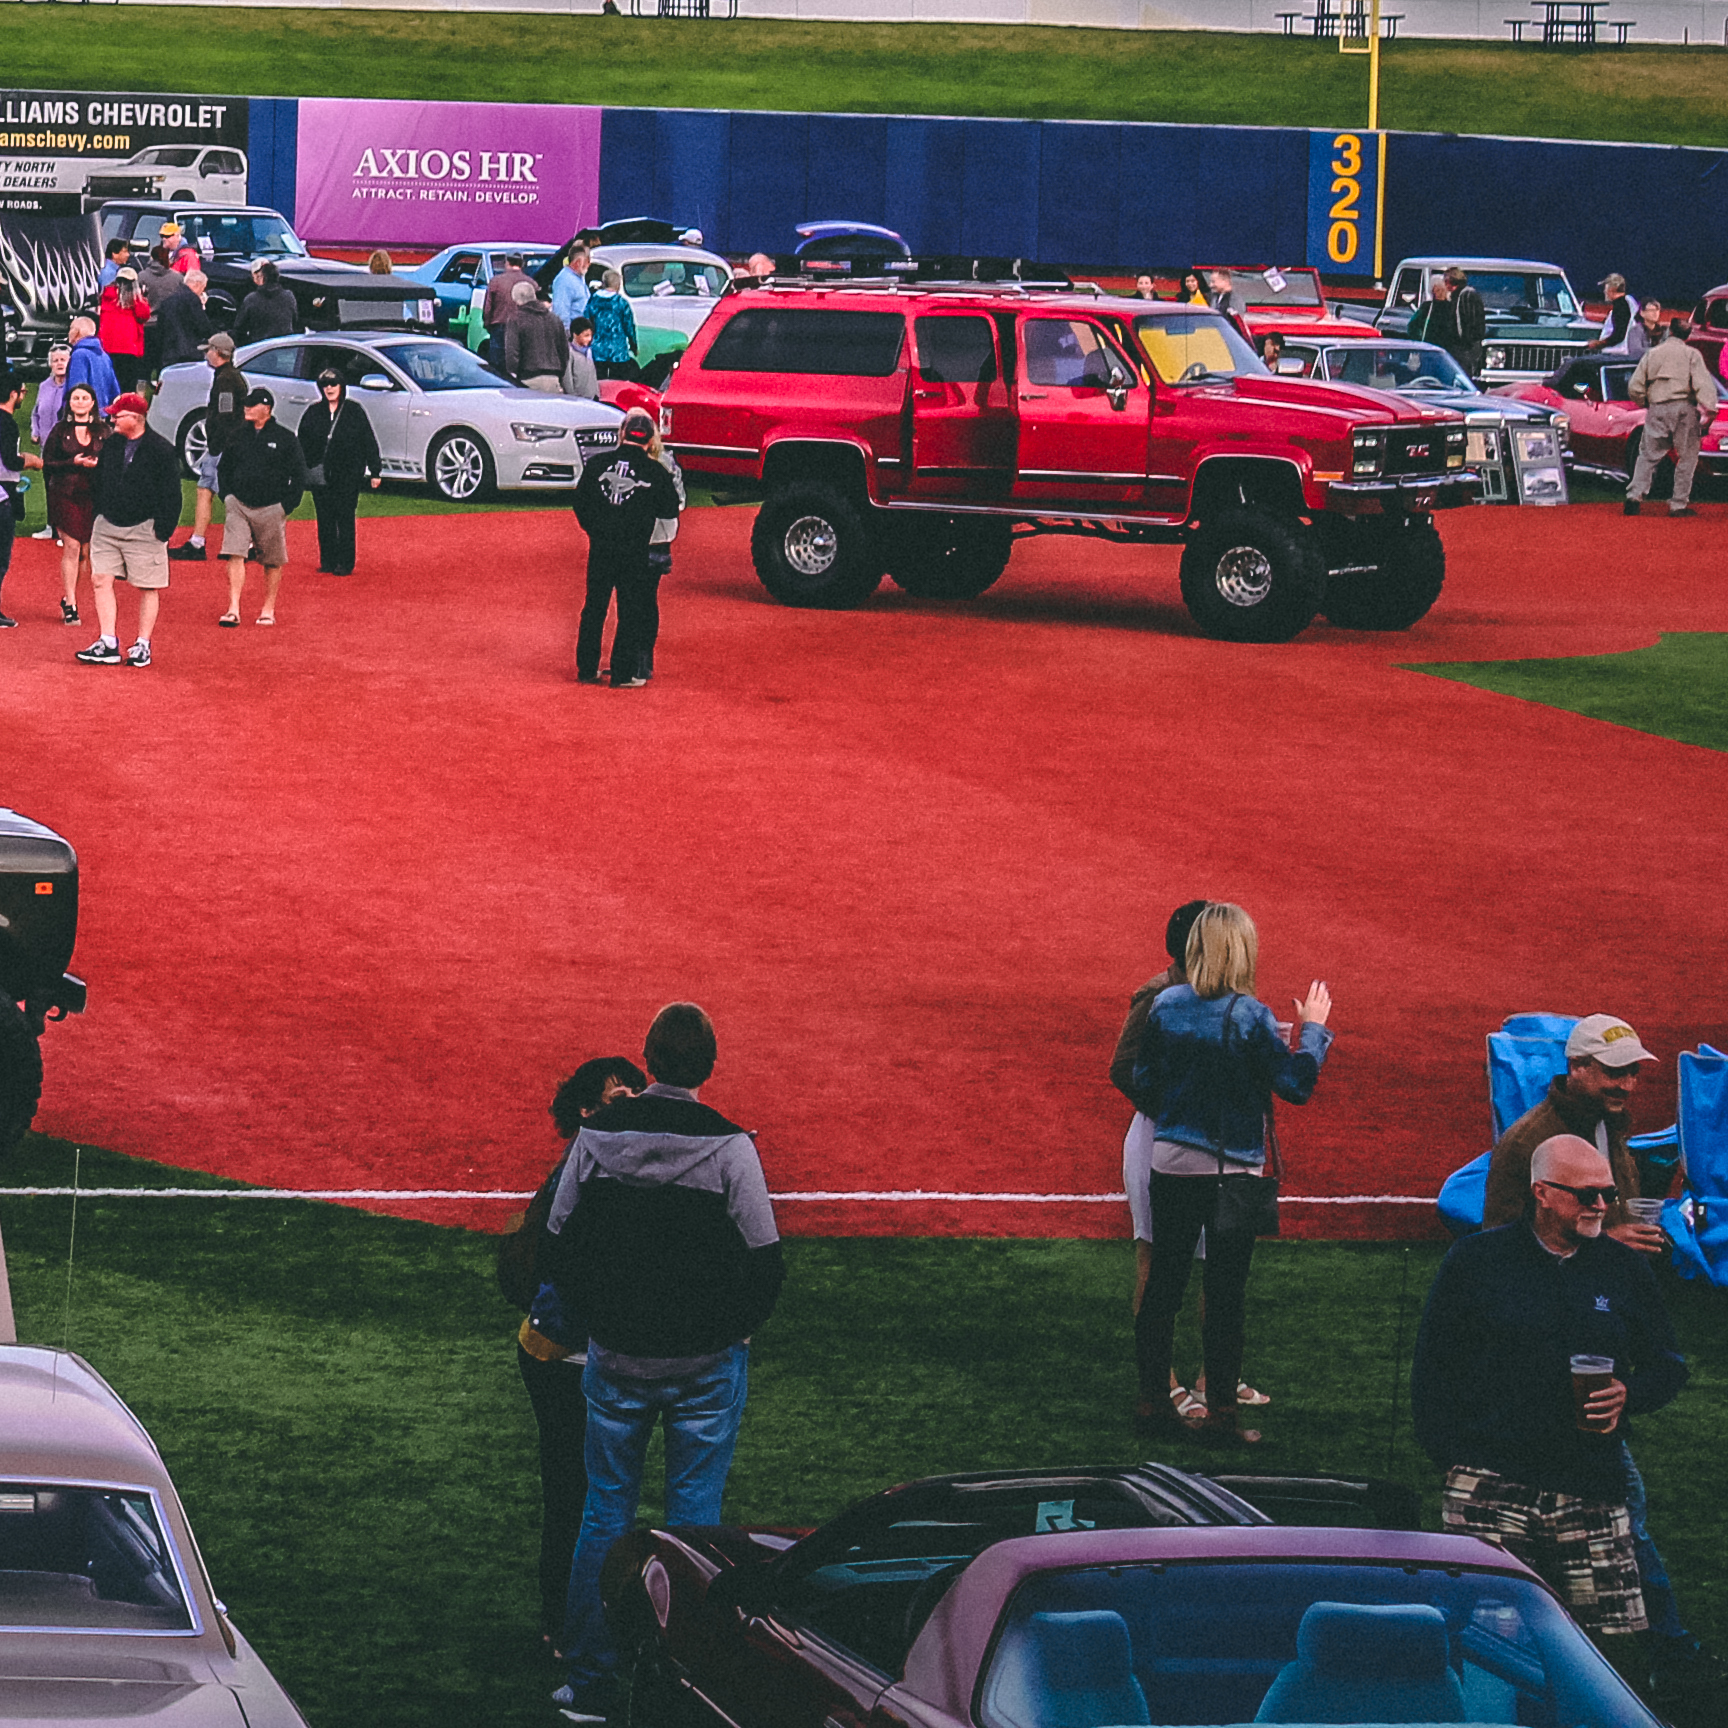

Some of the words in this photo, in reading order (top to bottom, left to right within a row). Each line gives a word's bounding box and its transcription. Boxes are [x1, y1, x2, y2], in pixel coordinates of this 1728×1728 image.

[87, 101, 227, 129] CHEVROLET
[13, 161, 56, 174] NORTH
[351, 147, 472, 181] AXIOS
[2, 176, 58, 189] DEALERS
[352, 187, 416, 201] ATTRACT.
[418, 189, 472, 203] RETAIN.
[1327, 133, 1362, 264] 320
[6, 199, 43, 211] ROADS.
